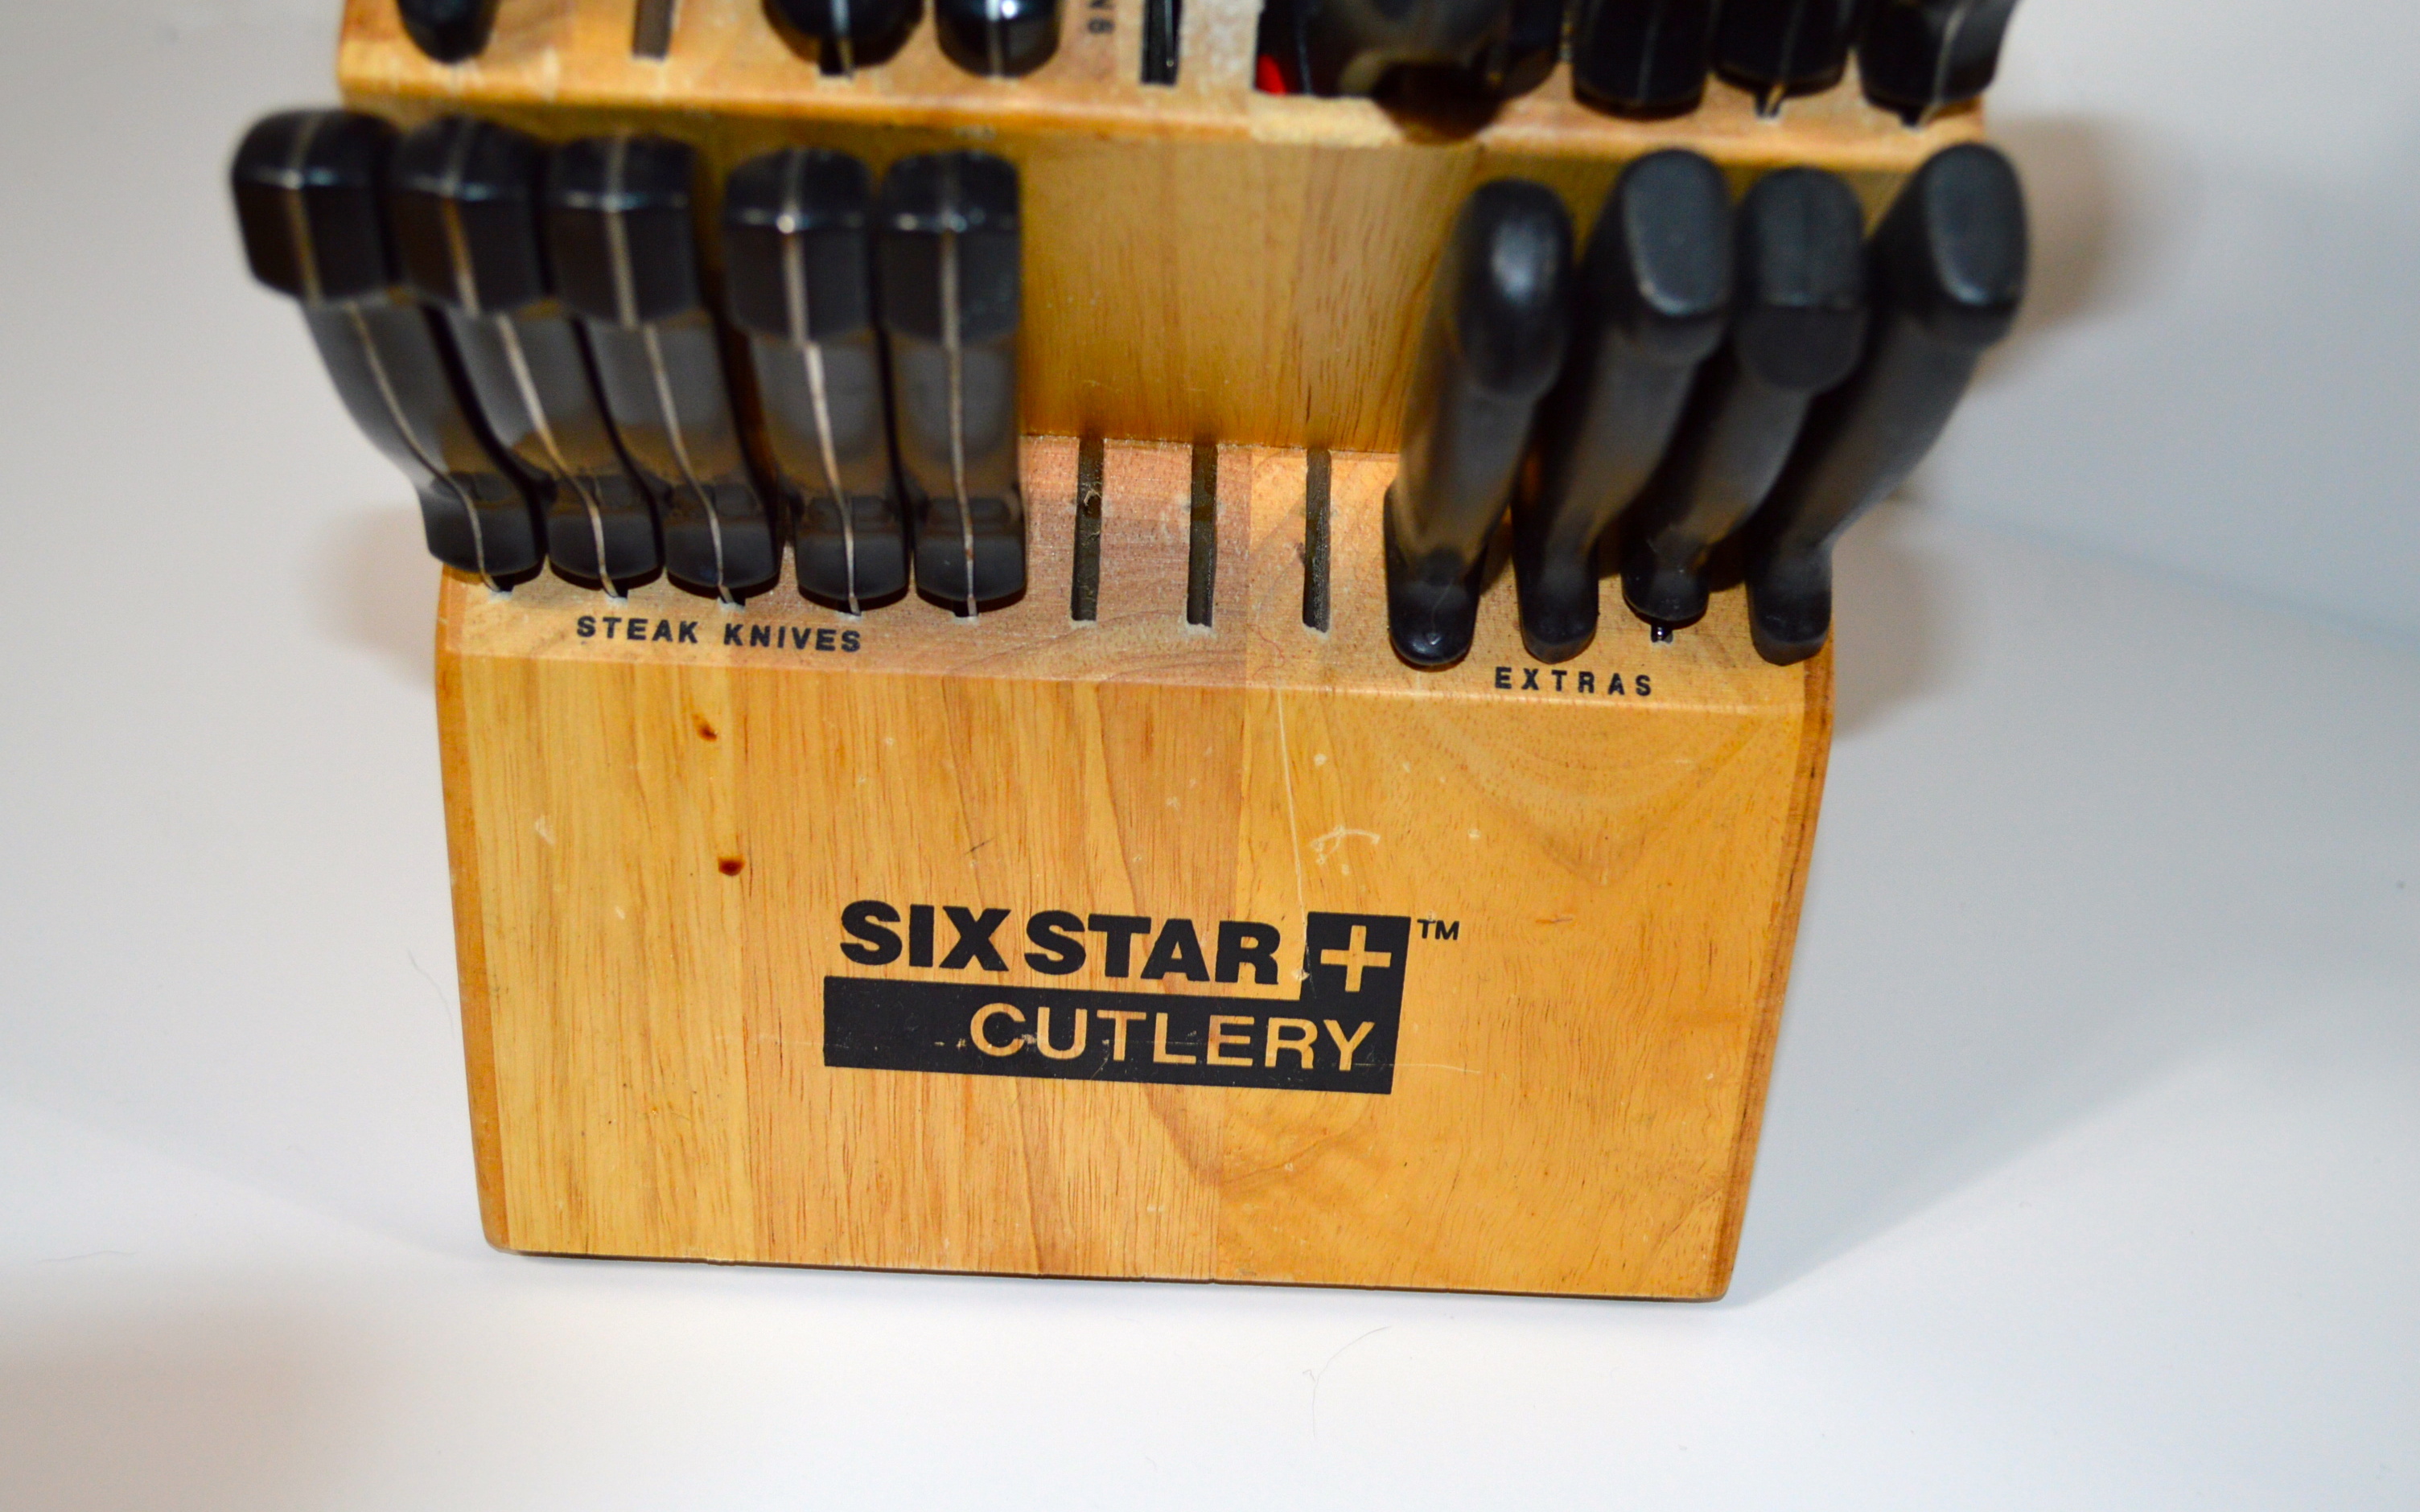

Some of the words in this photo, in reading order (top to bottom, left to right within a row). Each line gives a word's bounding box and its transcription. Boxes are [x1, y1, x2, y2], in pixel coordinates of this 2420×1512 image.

[576, 615, 698, 643] STEAK
[724, 623, 861, 652] KNIVES
[1494, 666, 1652, 696] EXTRAS
[839, 899, 1011, 972] SIX
[1024, 910, 1281, 985] STAR
[969, 1002, 1375, 1071] CUTLERY
